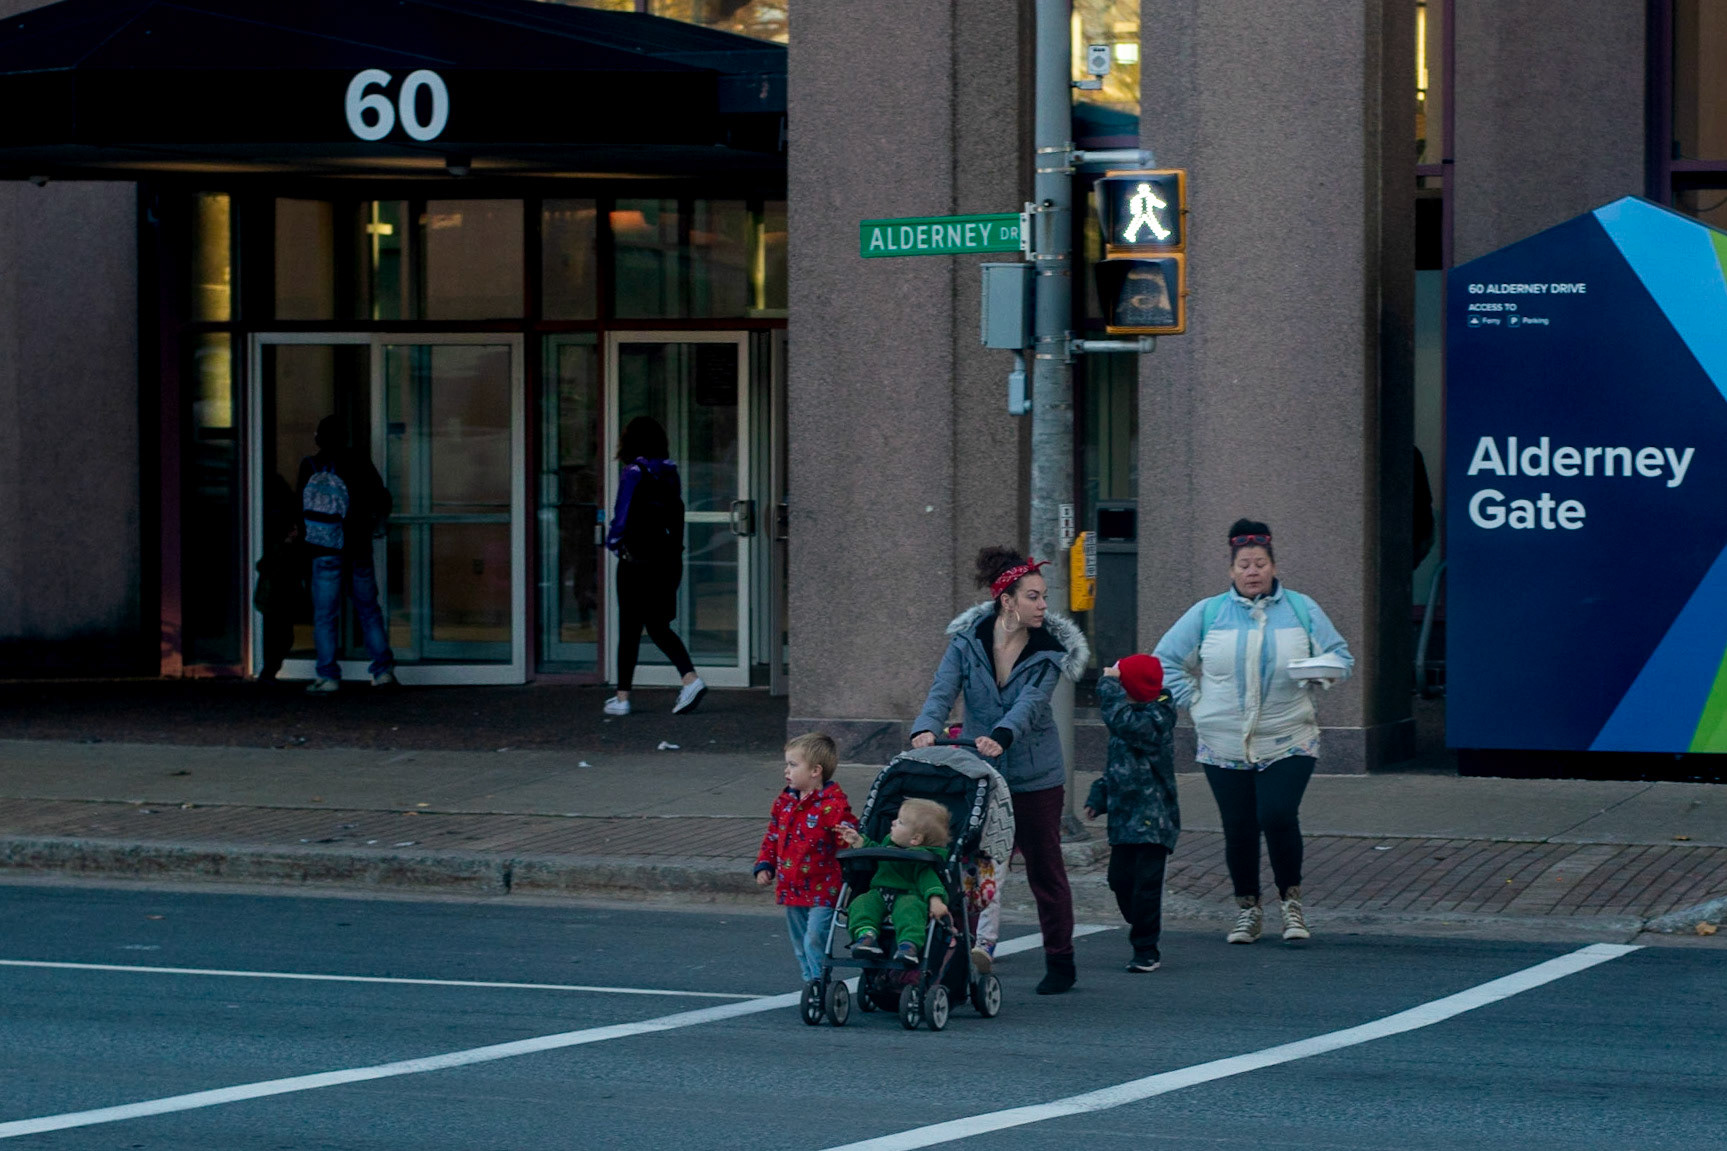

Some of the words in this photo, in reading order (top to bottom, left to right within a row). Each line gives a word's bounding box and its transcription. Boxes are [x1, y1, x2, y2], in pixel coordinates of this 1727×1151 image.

[345, 69, 449, 142] 60
[869, 223, 992, 251] ALDERNEY
[1000, 227, 1019, 240] DR
[1468, 283, 1485, 294] 60
[1486, 283, 1549, 294] ALDERNEY
[1550, 283, 1587, 294] DRIVE
[1468, 303, 1503, 311] ACCESS
[1504, 303, 1518, 311] TO
[1522, 317, 1550, 326] Parking
[1467, 436, 1695, 488] Alderney
[1468, 488, 1587, 530] Gate
